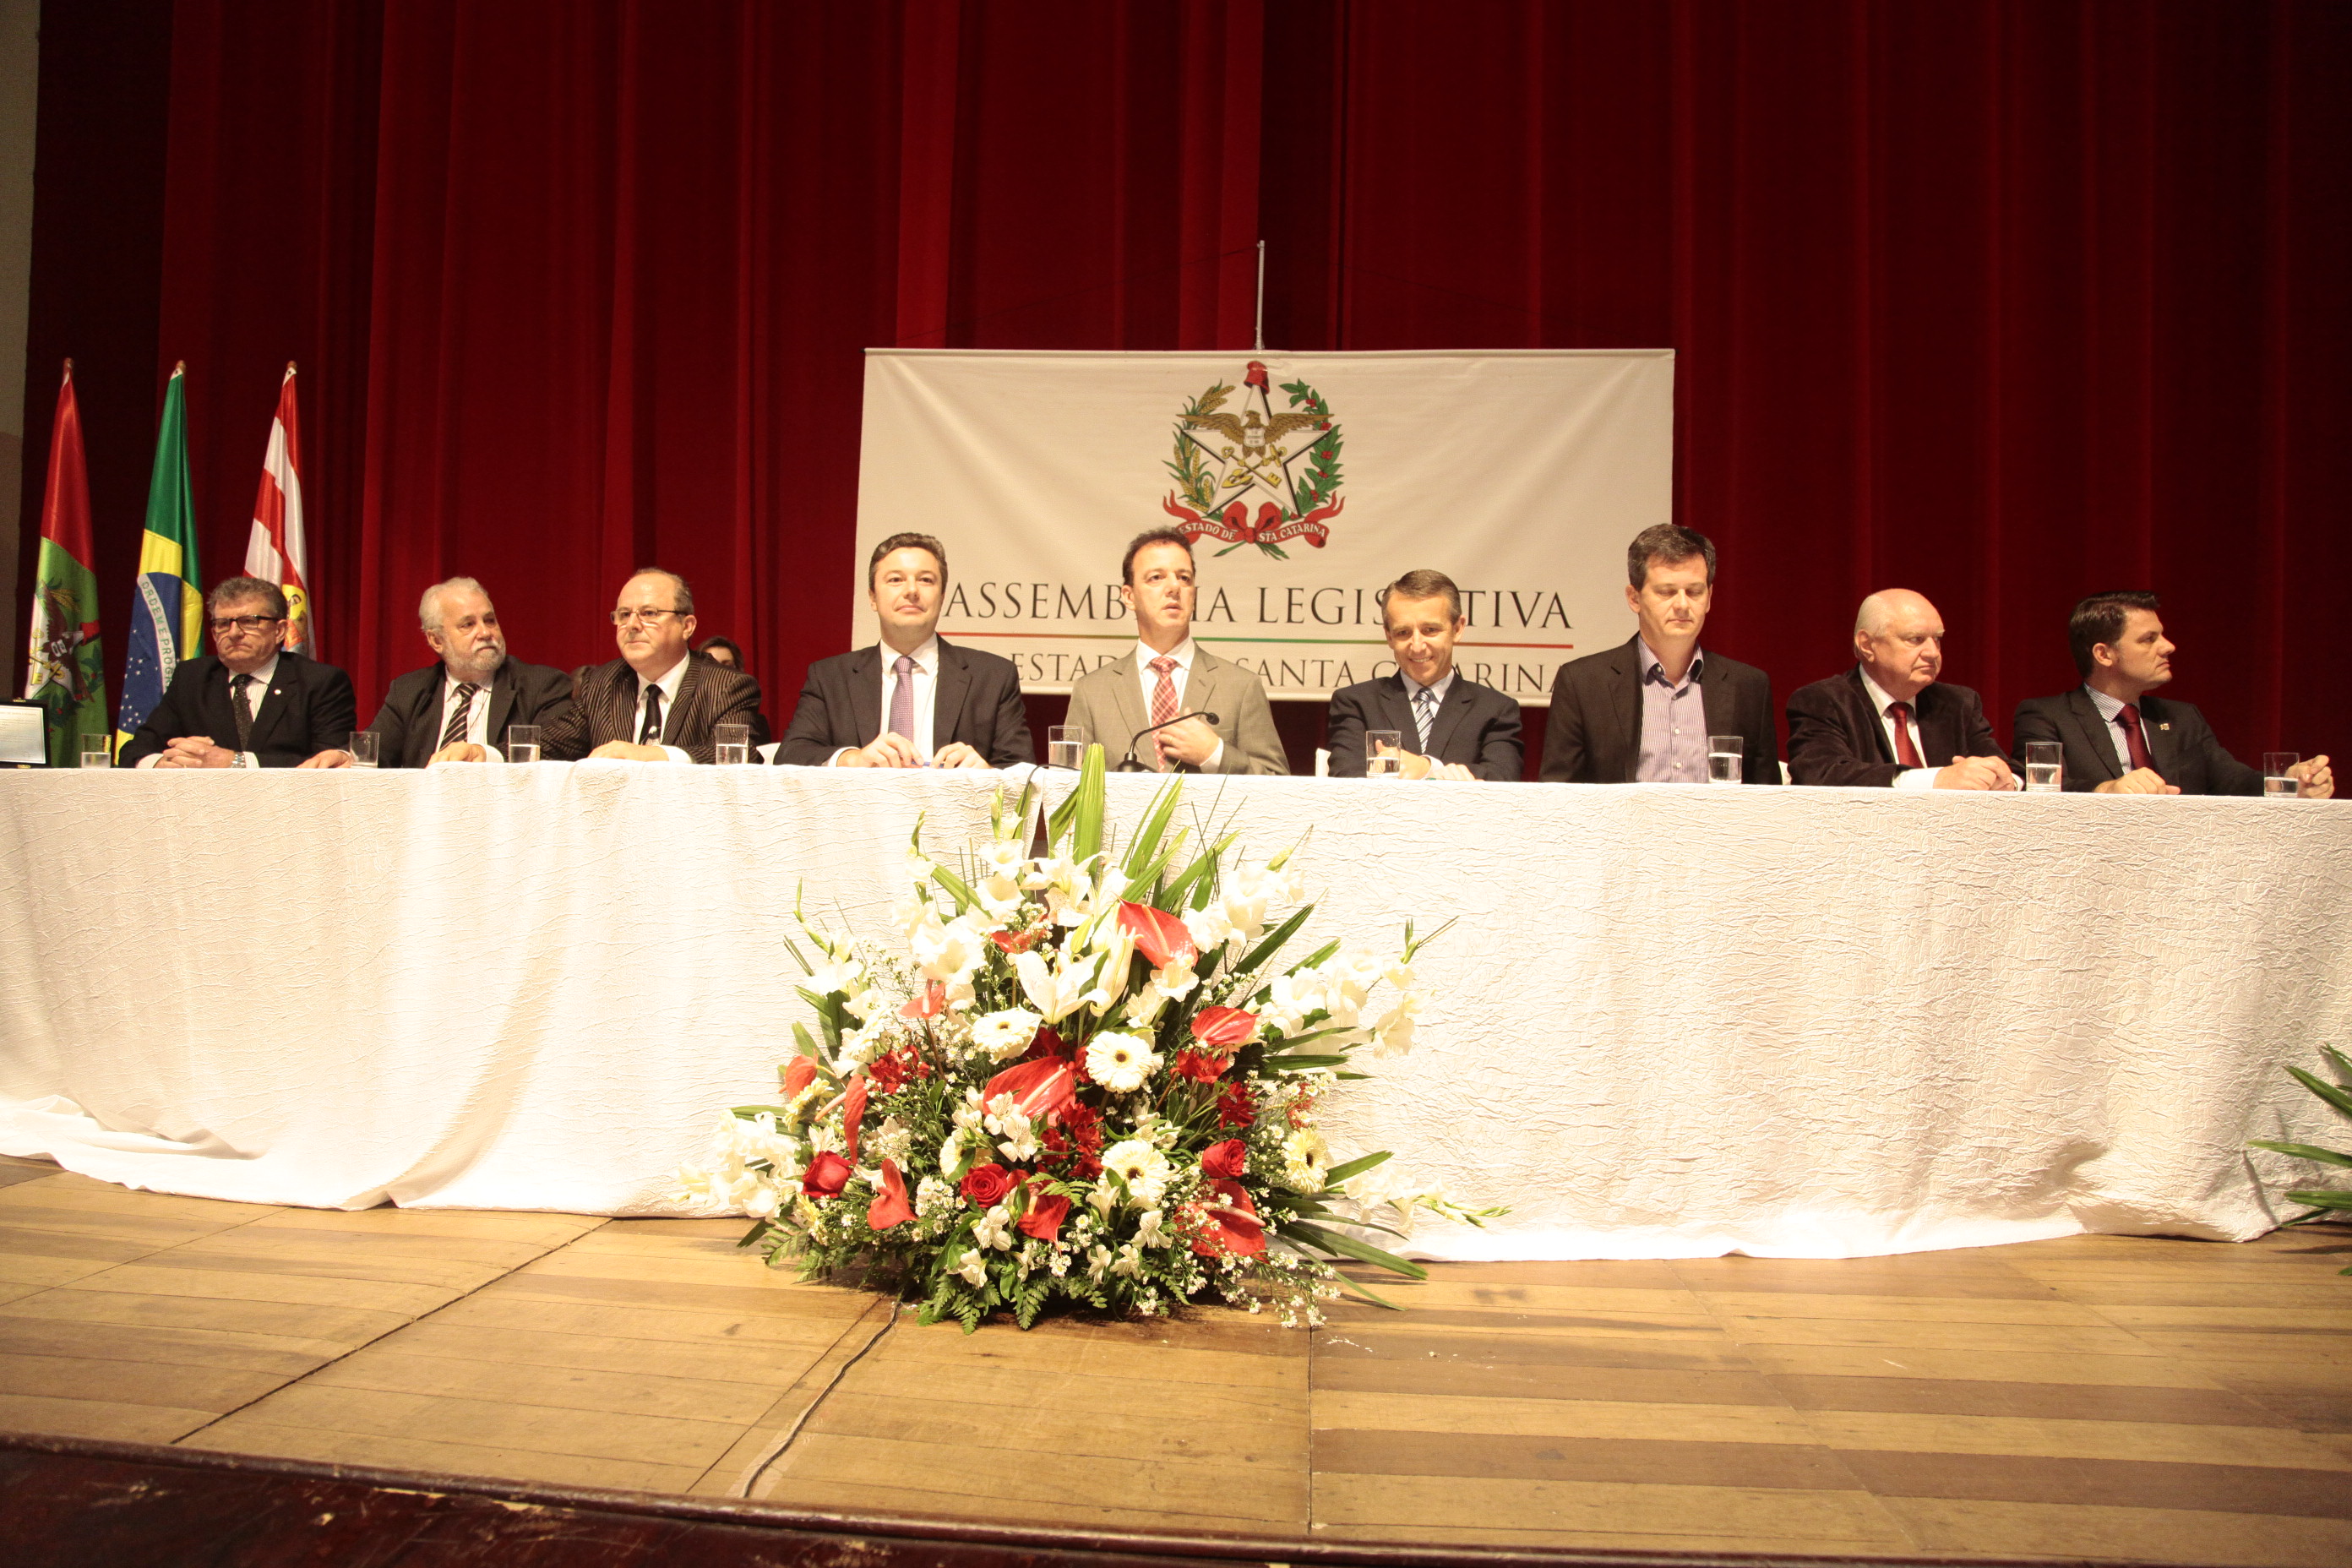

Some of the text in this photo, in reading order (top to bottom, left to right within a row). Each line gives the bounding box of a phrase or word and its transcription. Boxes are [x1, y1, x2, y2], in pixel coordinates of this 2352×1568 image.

[1221, 529, 1236, 541] DE
[1280, 523, 1326, 537] CATARINA
[943, 582, 1573, 629] ASSEMBIA LEGISTIVA
[141, 581, 164, 623] ORDEM
[161, 638, 173, 687] PROGR
